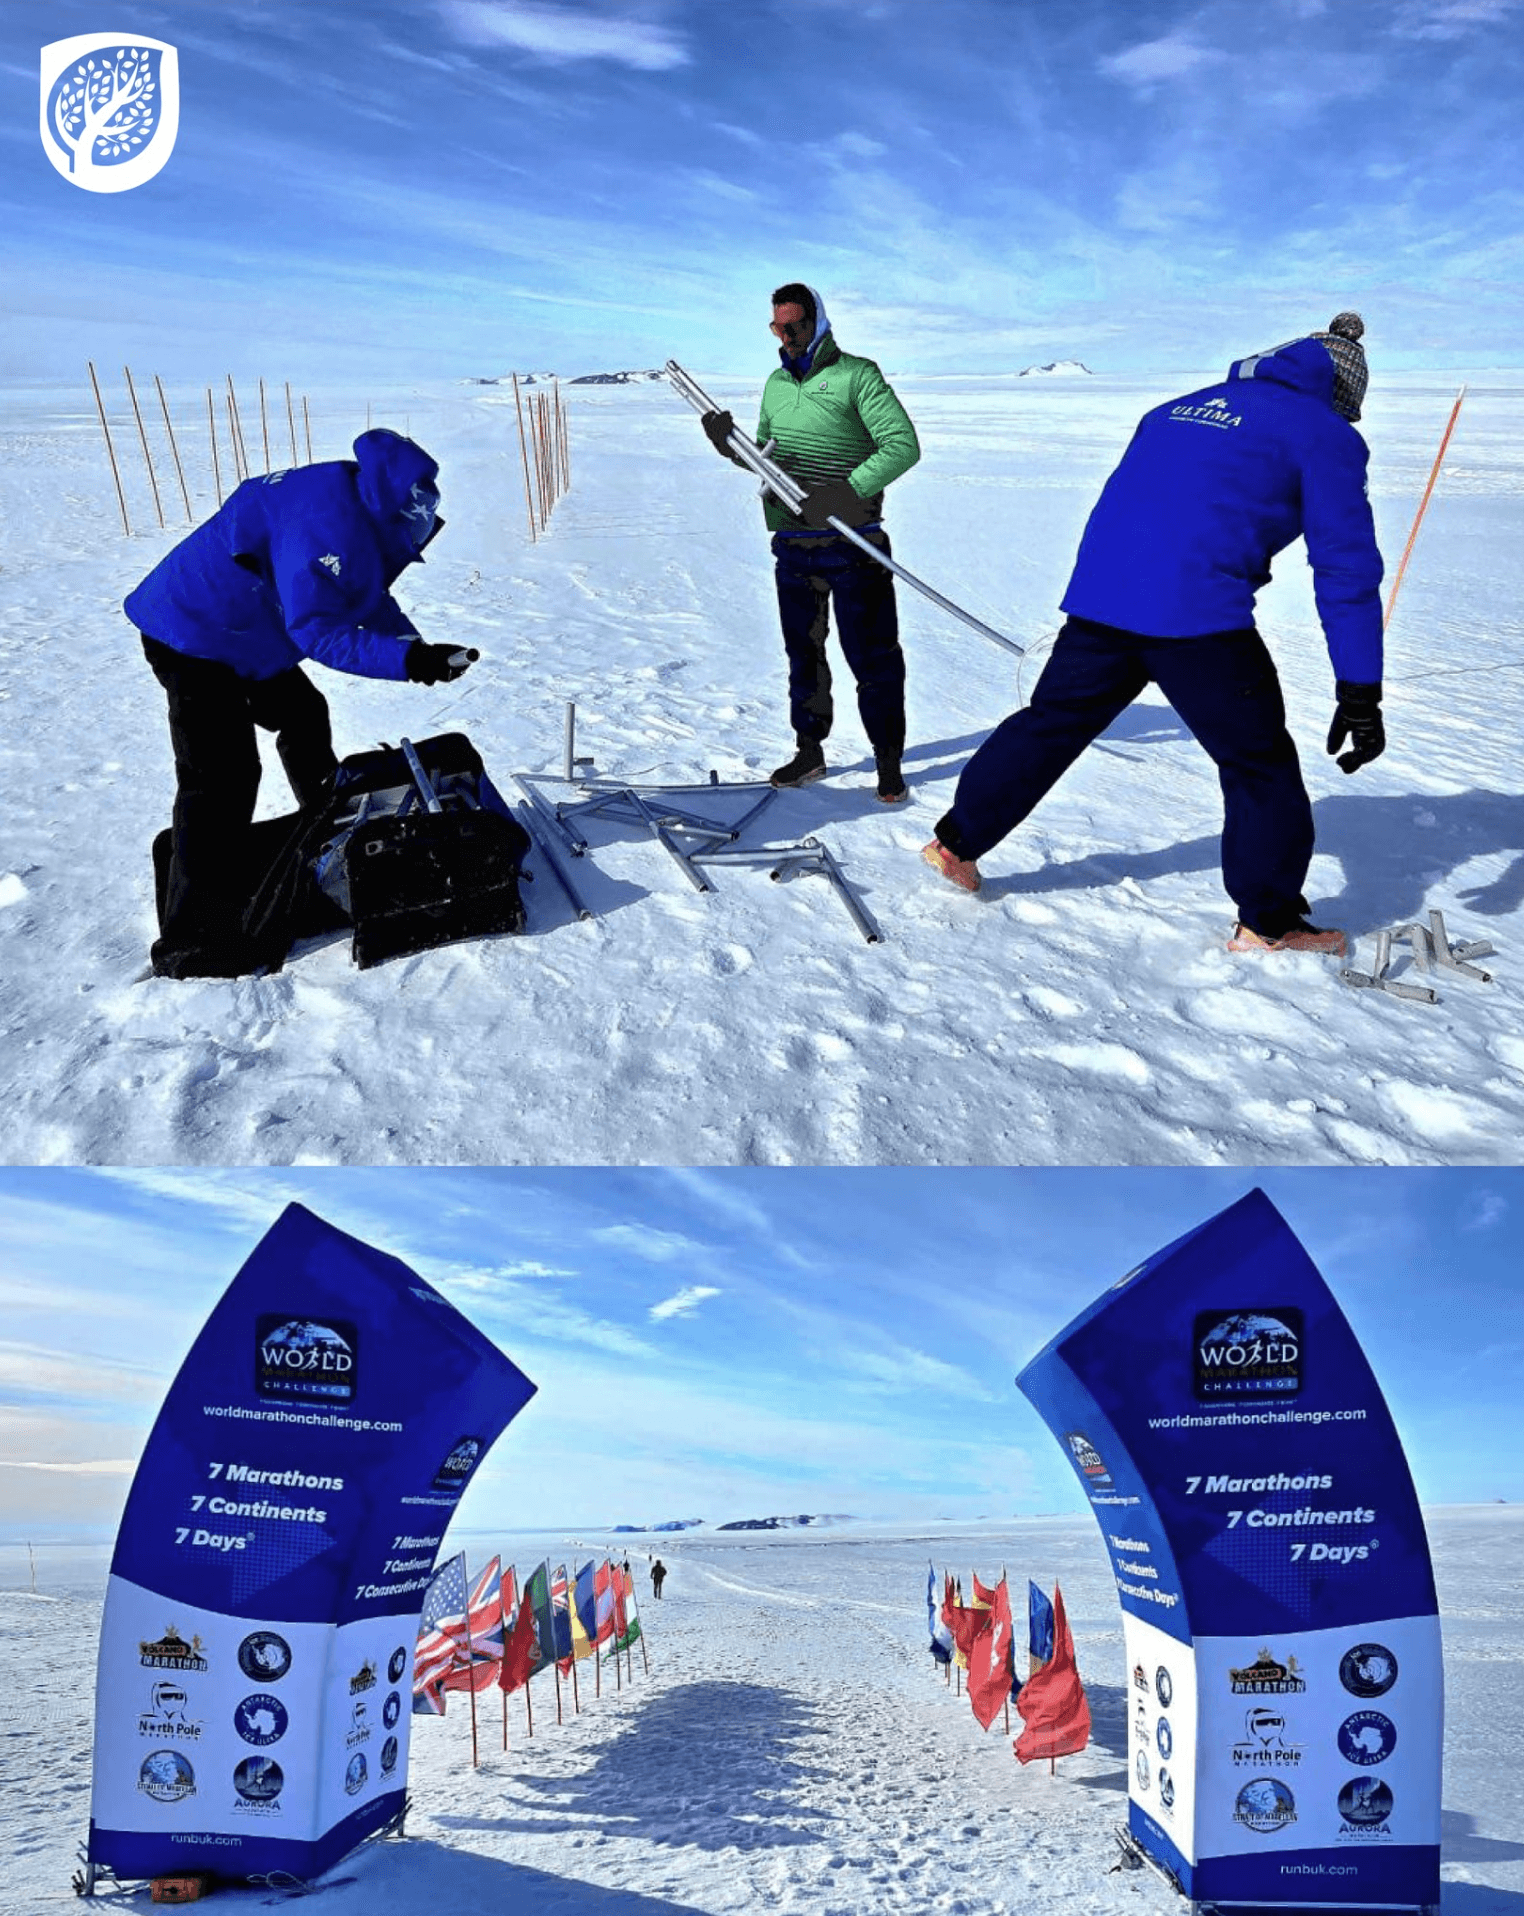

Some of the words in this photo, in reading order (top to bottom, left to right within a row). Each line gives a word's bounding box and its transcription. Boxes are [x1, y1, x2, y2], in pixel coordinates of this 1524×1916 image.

[1171, 405, 1242, 427] ULTIMA
[261, 1347, 352, 1372] WORLD
[1200, 1339, 1299, 1367] WORLD
[203, 1405, 403, 1432] worldmarathonchallenge.com
[1148, 1409, 1367, 1429] worldmarathonchallenge.com
[208, 1462, 224, 1479] 7
[225, 1464, 344, 1491] Marathons
[1185, 1475, 1202, 1494] 7
[1204, 1473, 1333, 1494] Marathons
[191, 1495, 207, 1512] 7
[208, 1497, 327, 1523] Continents
[1227, 1510, 1243, 1529] 7
[1246, 1506, 1376, 1528] Continents
[174, 1527, 190, 1544] 7
[391, 1536, 402, 1549] 7
[1290, 1543, 1306, 1562] 7
[382, 1560, 393, 1574] 7
[355, 1584, 366, 1600] 7
[141, 1655, 208, 1672] MARATHON
[1231, 1667, 1282, 1683] VOLCANO
[1232, 1680, 1306, 1695] MARATHON
[176, 1722, 201, 1736] Pole
[1275, 1749, 1302, 1760] Pole
[234, 1799, 282, 1810] AURORA
[1338, 1822, 1392, 1834] AURORA
[171, 1834, 242, 1847] runbuk.com
[1280, 1863, 1358, 1876] runbuk.com
